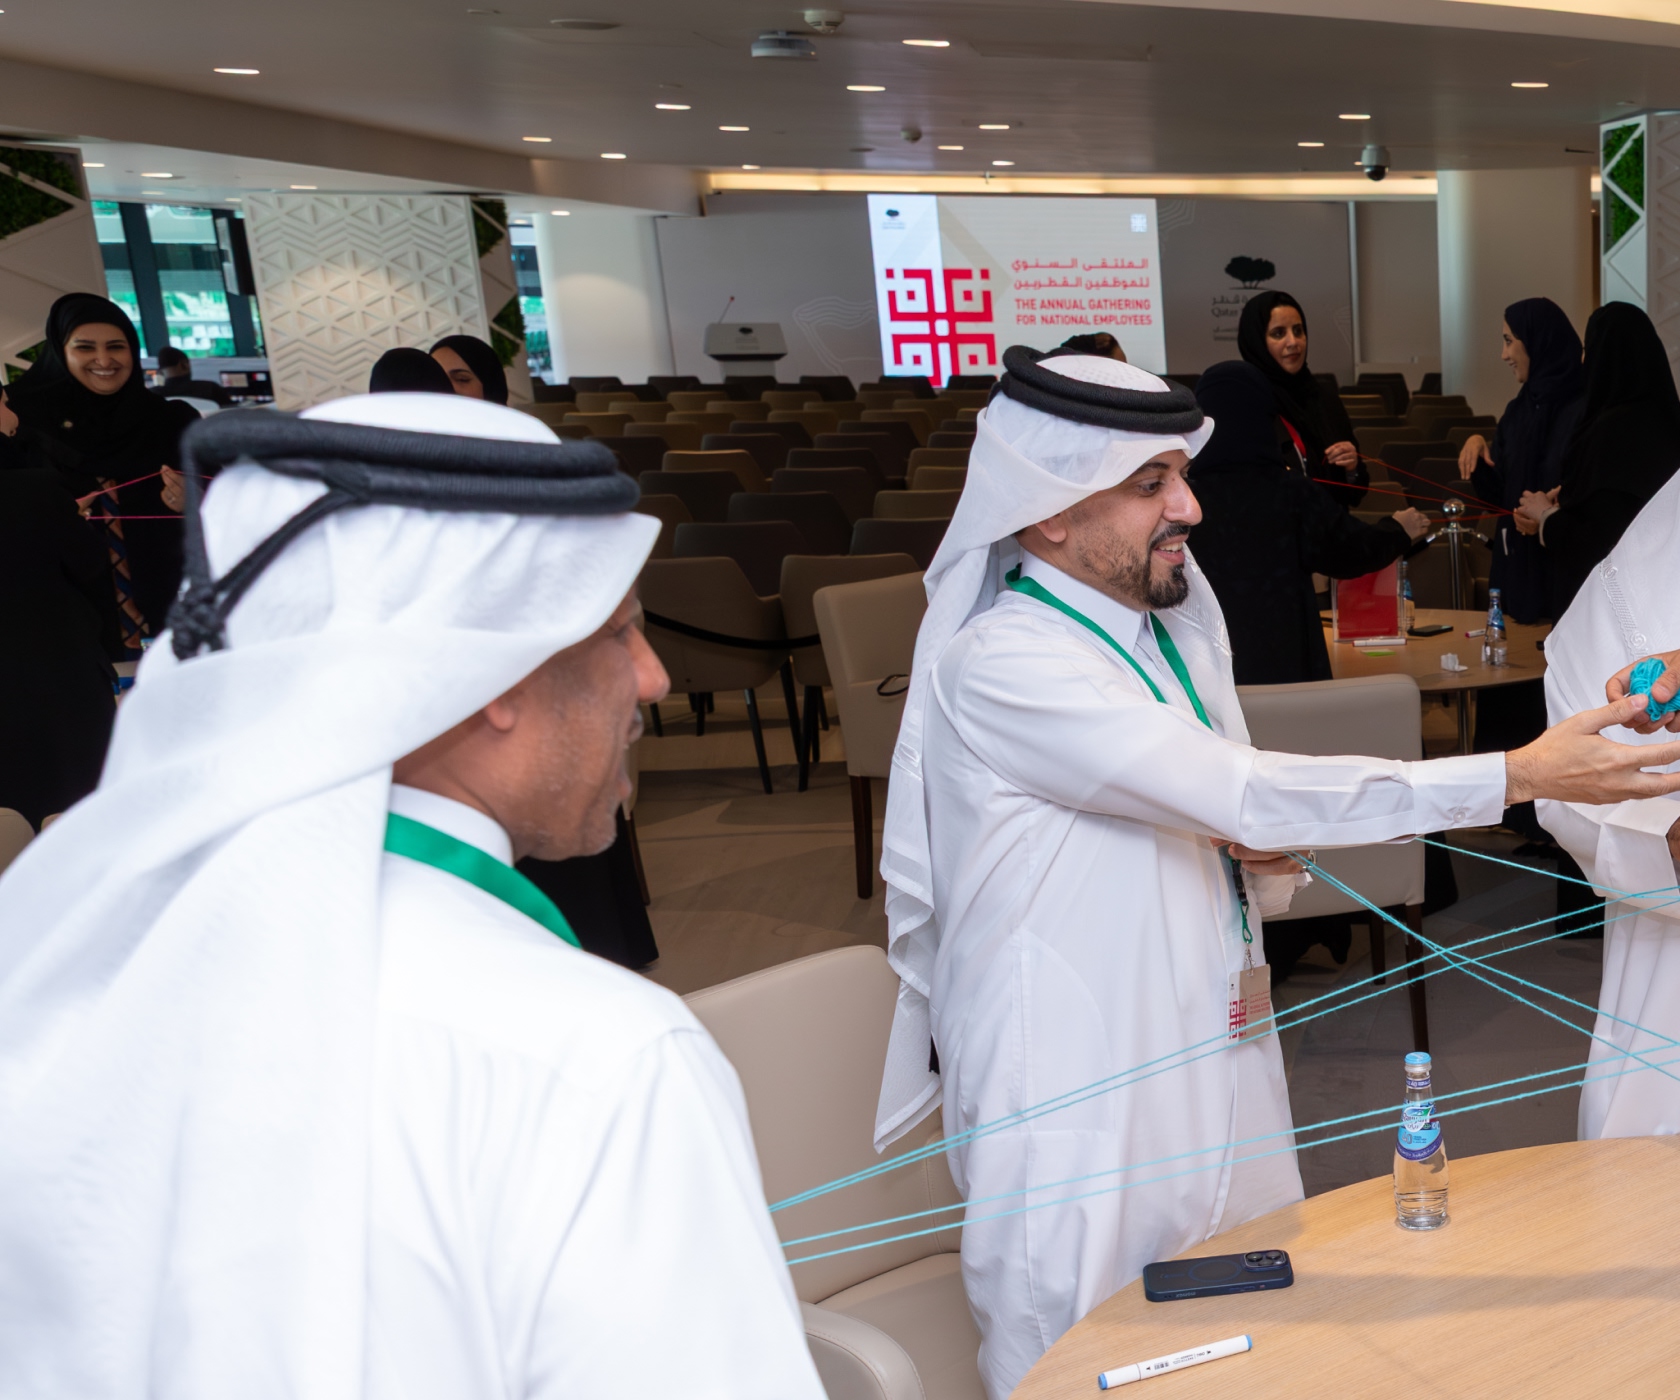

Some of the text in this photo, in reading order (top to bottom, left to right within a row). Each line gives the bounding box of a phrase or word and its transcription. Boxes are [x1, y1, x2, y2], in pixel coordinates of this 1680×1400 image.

[1011, 258, 1149, 273] الملتقى السنوي
[1014, 276, 1150, 290] للموظفين القطريين
[1014, 298, 1151, 310] THE ANNUAL GATHERING
[1016, 314, 1153, 326] FOR NATIONAL EMPLOYEES
